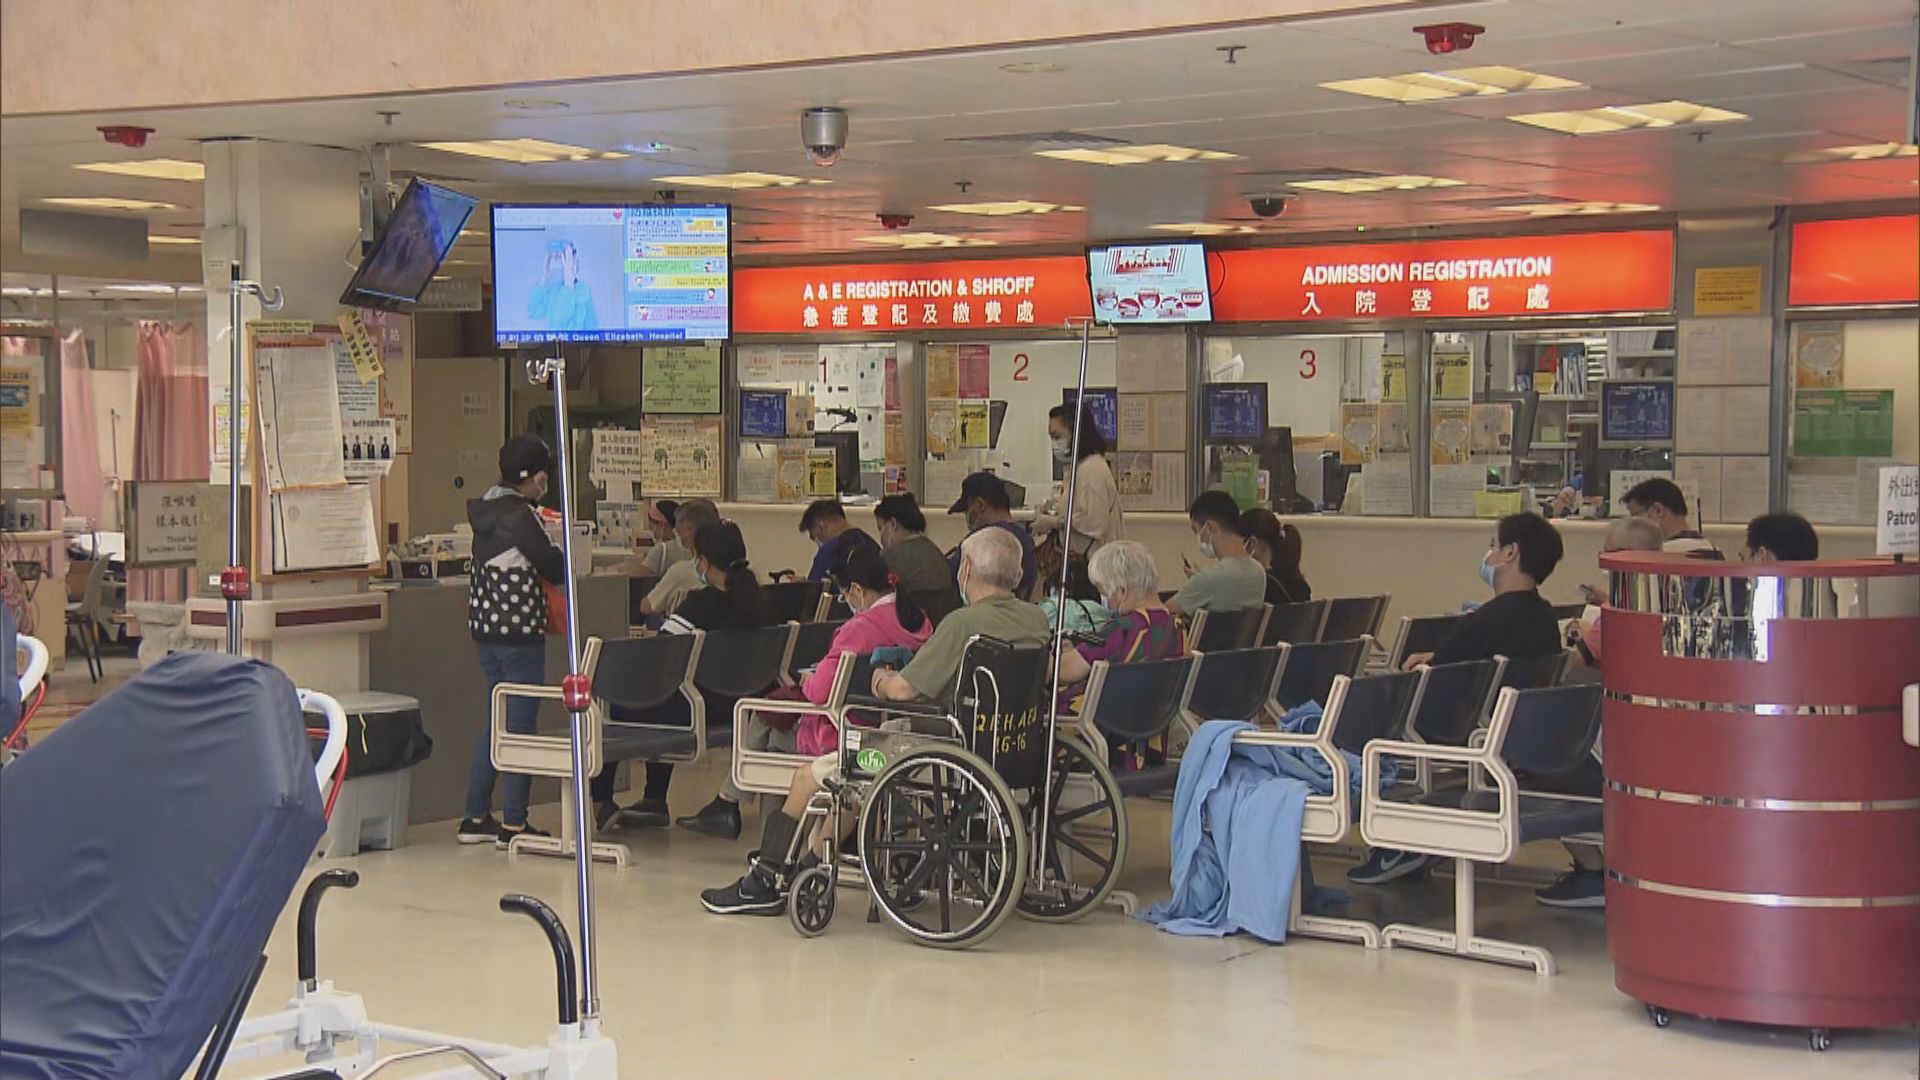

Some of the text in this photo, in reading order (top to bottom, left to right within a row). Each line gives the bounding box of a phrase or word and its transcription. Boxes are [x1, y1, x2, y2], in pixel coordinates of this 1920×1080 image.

[1301, 256, 1552, 285] ADMISSION REGISTRATION
[803, 276, 1035, 301] A & E REGISTRATION & SHROFF
[1301, 283, 1549, 315] 入院登記處
[803, 300, 1034, 328] 急症登記及繳費處
[572, 333, 600, 342] Queen
[605, 333, 644, 341] Elizabeth
[650, 332, 683, 341] Hospital
[819, 356, 828, 384] 1
[1013, 353, 1029, 381] 2
[1299, 350, 1317, 380] 3
